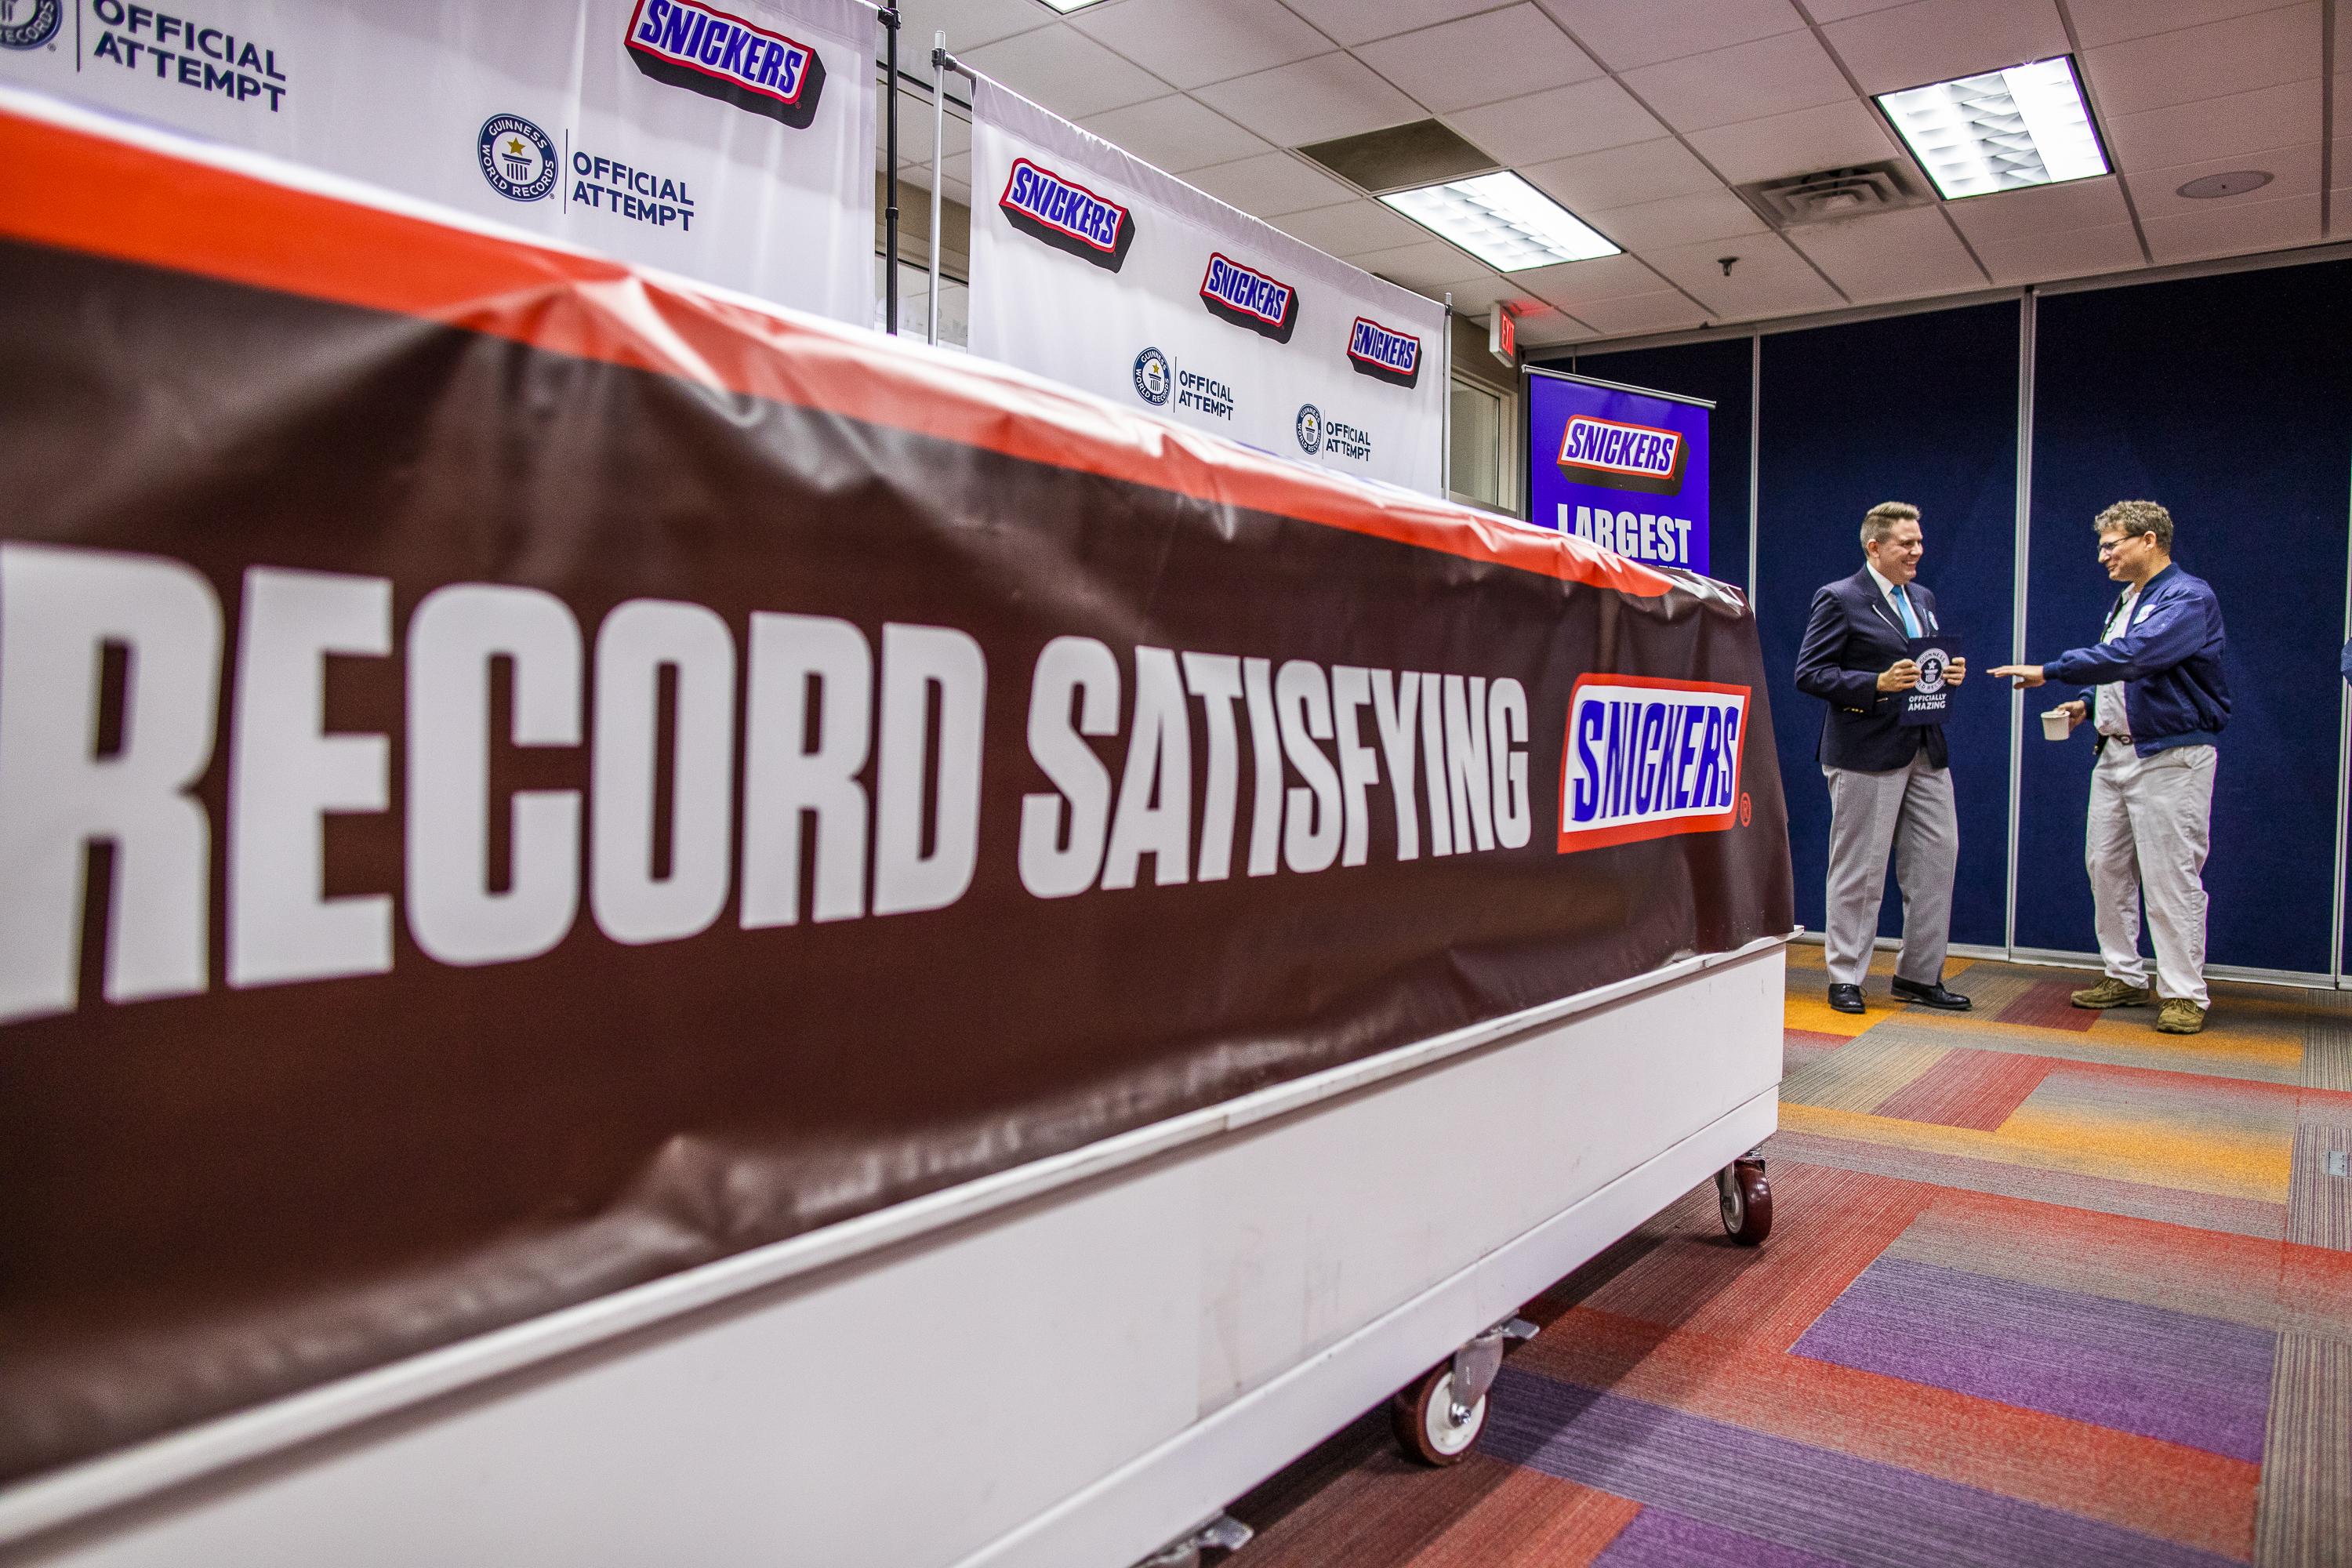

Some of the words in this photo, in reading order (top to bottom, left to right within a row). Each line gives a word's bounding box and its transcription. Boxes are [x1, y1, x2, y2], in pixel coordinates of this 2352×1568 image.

[93, 0, 285, 81] OFFICIAL
[637, 0, 804, 94] SNICKERS
[94, 31, 285, 112] ATTEMPT
[488, 119, 547, 149] GUINNESS
[482, 144, 508, 190] WORLD
[512, 160, 554, 197] RECORDS
[573, 151, 695, 205] OFFICIAL
[572, 180, 695, 231] ATTEMPT
[1011, 166, 1118, 245] SNICKERS
[1207, 260, 1287, 320] SNICKERS
[1353, 322, 1416, 369] SNICKERS
[1501, 313, 1515, 358] EXIT
[1141, 350, 1167, 371] GUINNESS
[1135, 368, 1151, 398] WORLD
[1152, 378, 1169, 403] RECORDS
[1178, 389, 1234, 421] ATTEMPT
[1179, 370, 1234, 403] OFFICIAL
[1298, 423, 1308, 448] WORLD
[1300, 407, 1320, 423] GUINNESS
[1326, 421, 1370, 446] OFFICIAL
[1325, 438, 1370, 462] ATTEMPT
[1566, 423, 1675, 472] SNICKERS
[1907, 701, 1946, 712] AMAZING
[1908, 693, 1947, 702] OFFICIALLY
[0, 539, 988, 1021] RECORD
[1018, 635, 1532, 900] SATISFYING
[1571, 699, 1740, 822] SNICKERS
